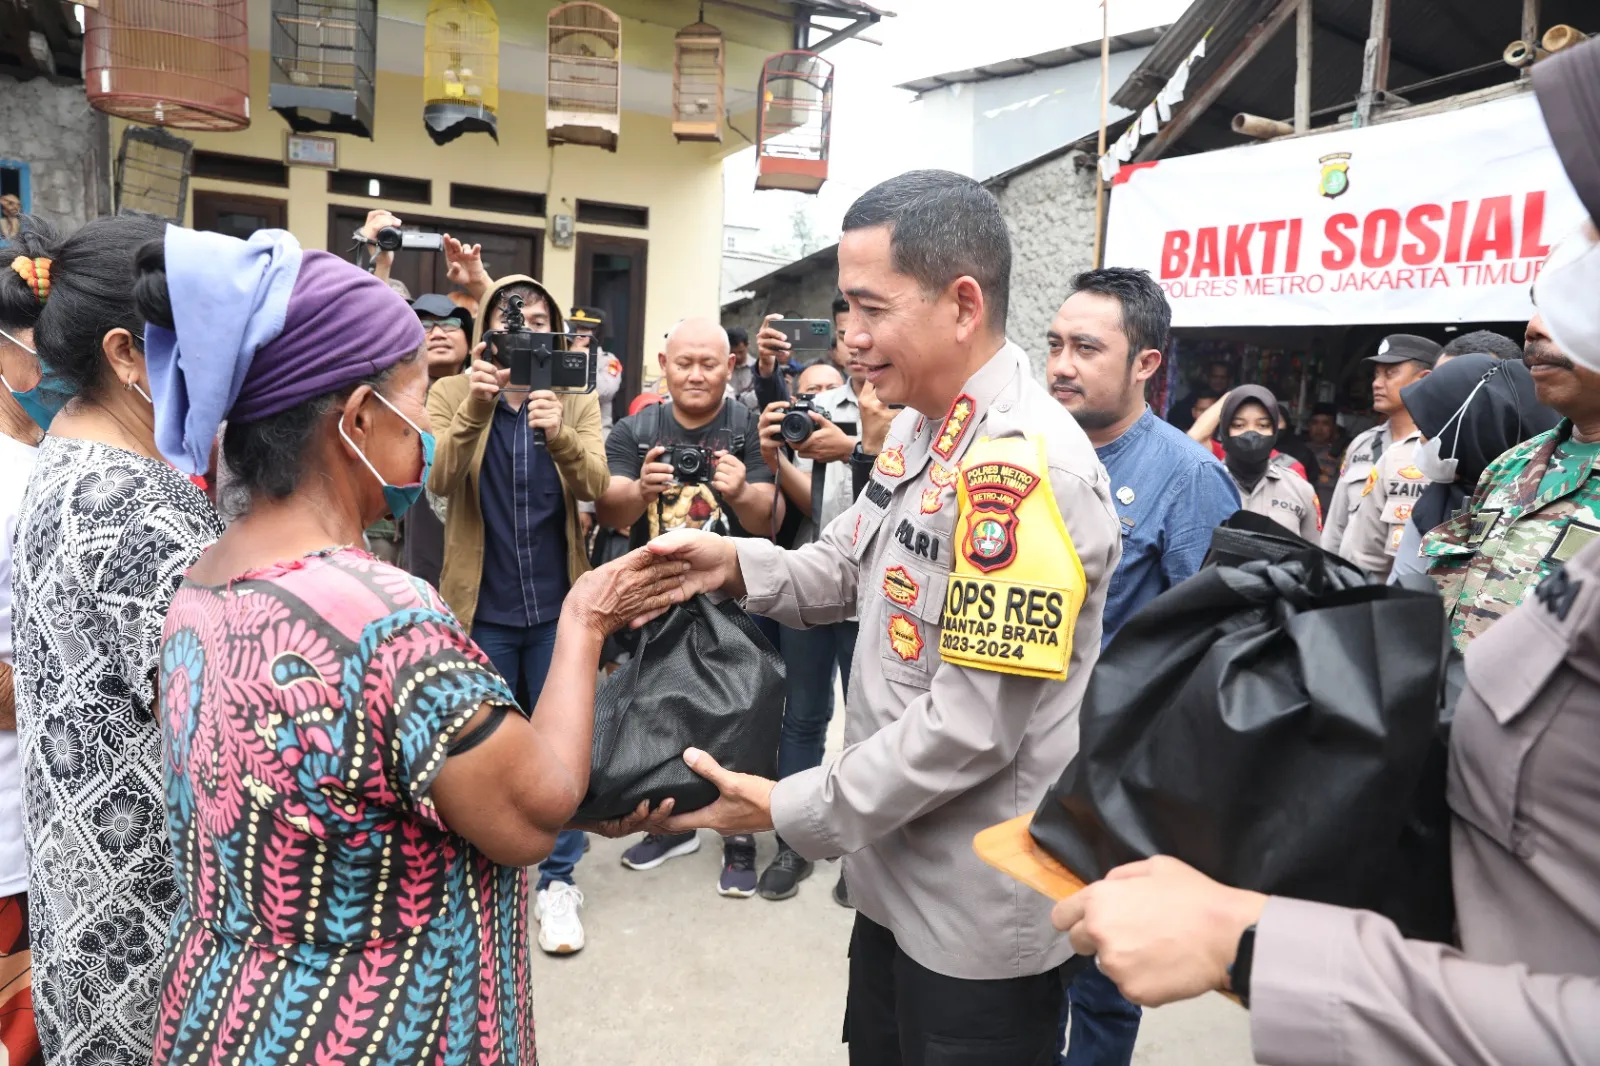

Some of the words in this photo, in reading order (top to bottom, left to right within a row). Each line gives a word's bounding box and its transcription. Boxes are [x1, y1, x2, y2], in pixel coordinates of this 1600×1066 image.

[1160, 218, 1303, 280] BAKTI
[1321, 190, 1551, 271] SOSIAL
[1160, 279, 1237, 299] POLRES
[1244, 274, 1325, 296] METRO
[1330, 267, 1450, 293] JAKARTA
[967, 465, 998, 480] POLRES
[1001, 465, 1033, 485] METRO
[1002, 476, 1028, 493] TIMUR
[1271, 499, 1305, 517] POLRI
[894, 518, 940, 561] POLRI
[1004, 586, 1063, 629] RES
[941, 633, 1025, 660] 2023-2024
[1001, 624, 1059, 647] BRATA
